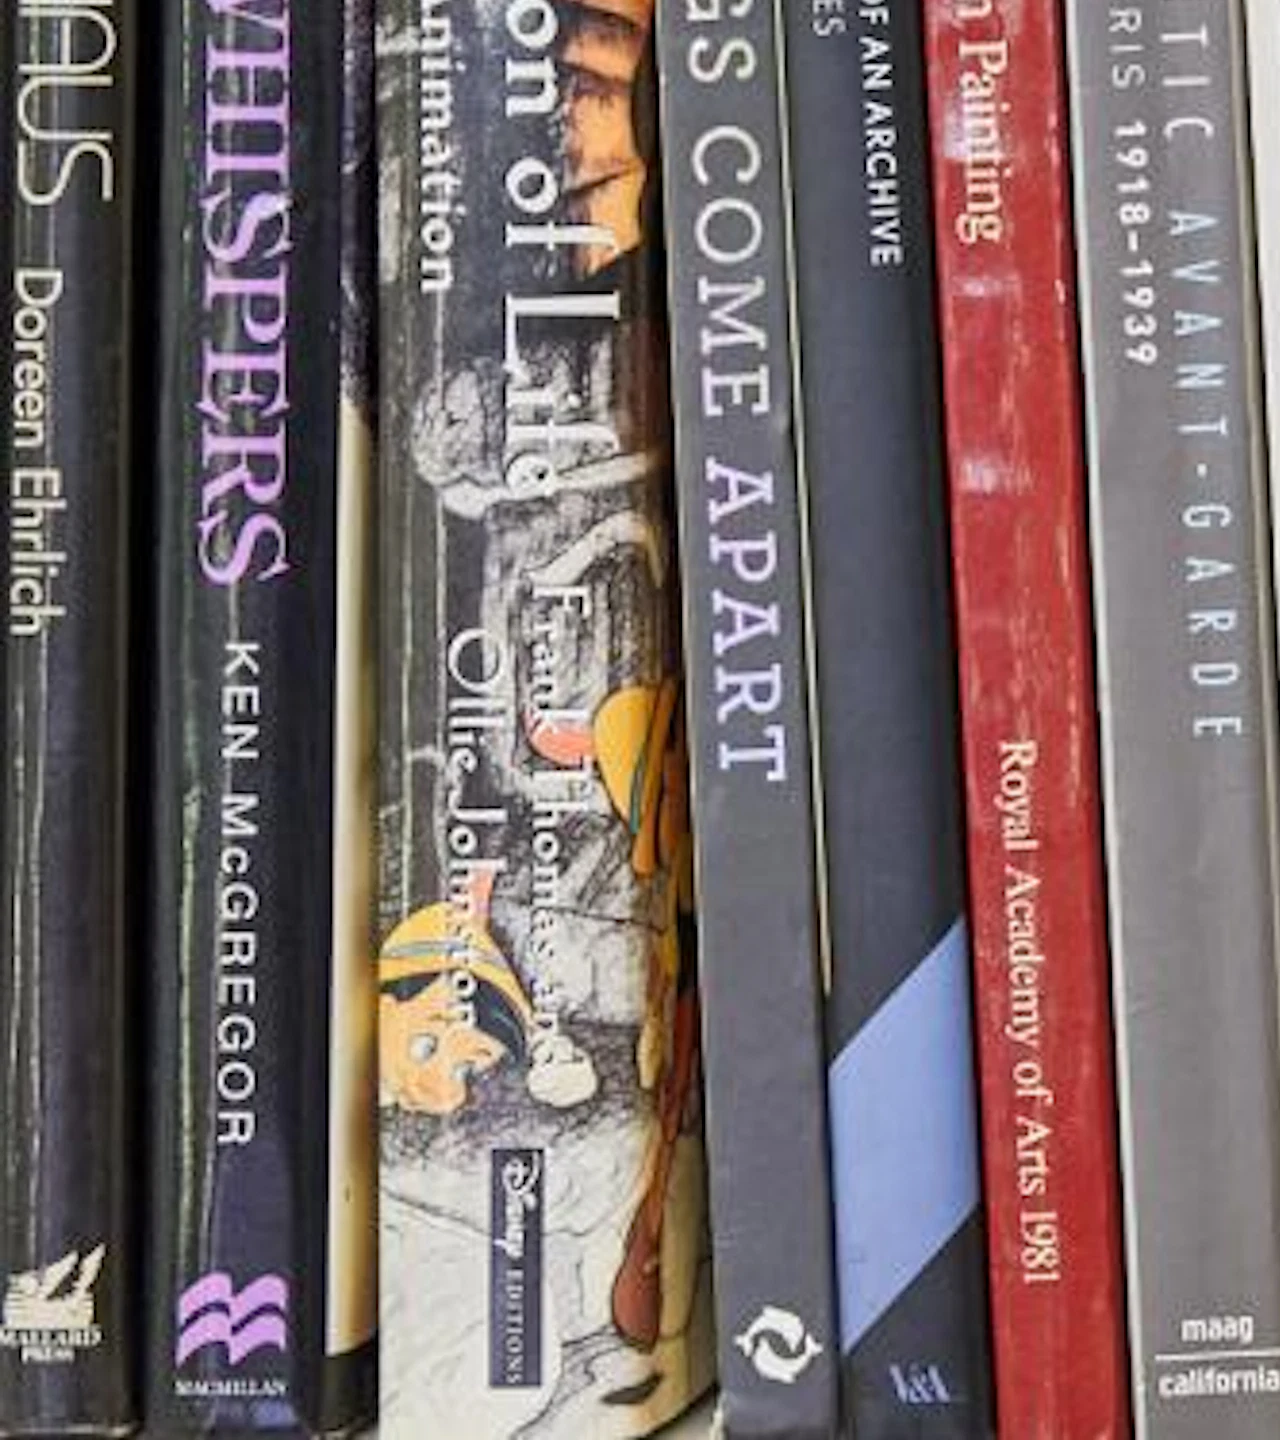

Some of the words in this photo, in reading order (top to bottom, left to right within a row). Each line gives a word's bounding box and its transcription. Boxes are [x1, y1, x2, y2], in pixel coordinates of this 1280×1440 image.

[859, 34, 893, 86] AN
[506, 158, 619, 270] of
[862, 93, 902, 266] ARCHIVE
[957, 38, 1008, 246] Painting
[691, 125, 770, 418] COME
[1113, 119, 1159, 367] 1918-1939
[14, 270, 63, 448] Doreen
[505, 293, 622, 490] Life
[8, 467, 67, 636] Ehrlich
[1166, 209, 1241, 739] AVANT-GARDE
[532, 585, 591, 736] Frank
[704, 456, 786, 781] APART
[219, 638, 262, 760] KEN
[447, 628, 507, 774] Ollie
[1001, 737, 1040, 851] Royal
[215, 793, 260, 1146] McGREGOR
[1004, 865, 1049, 1052] Academy
[1013, 1057, 1054, 1105] of
[1015, 1113, 1056, 1194] Arts
[1022, 1212, 1061, 1285] 1981
[1181, 1313, 1254, 1343] maag
[174, 1380, 288, 1397] MACMILLAN
